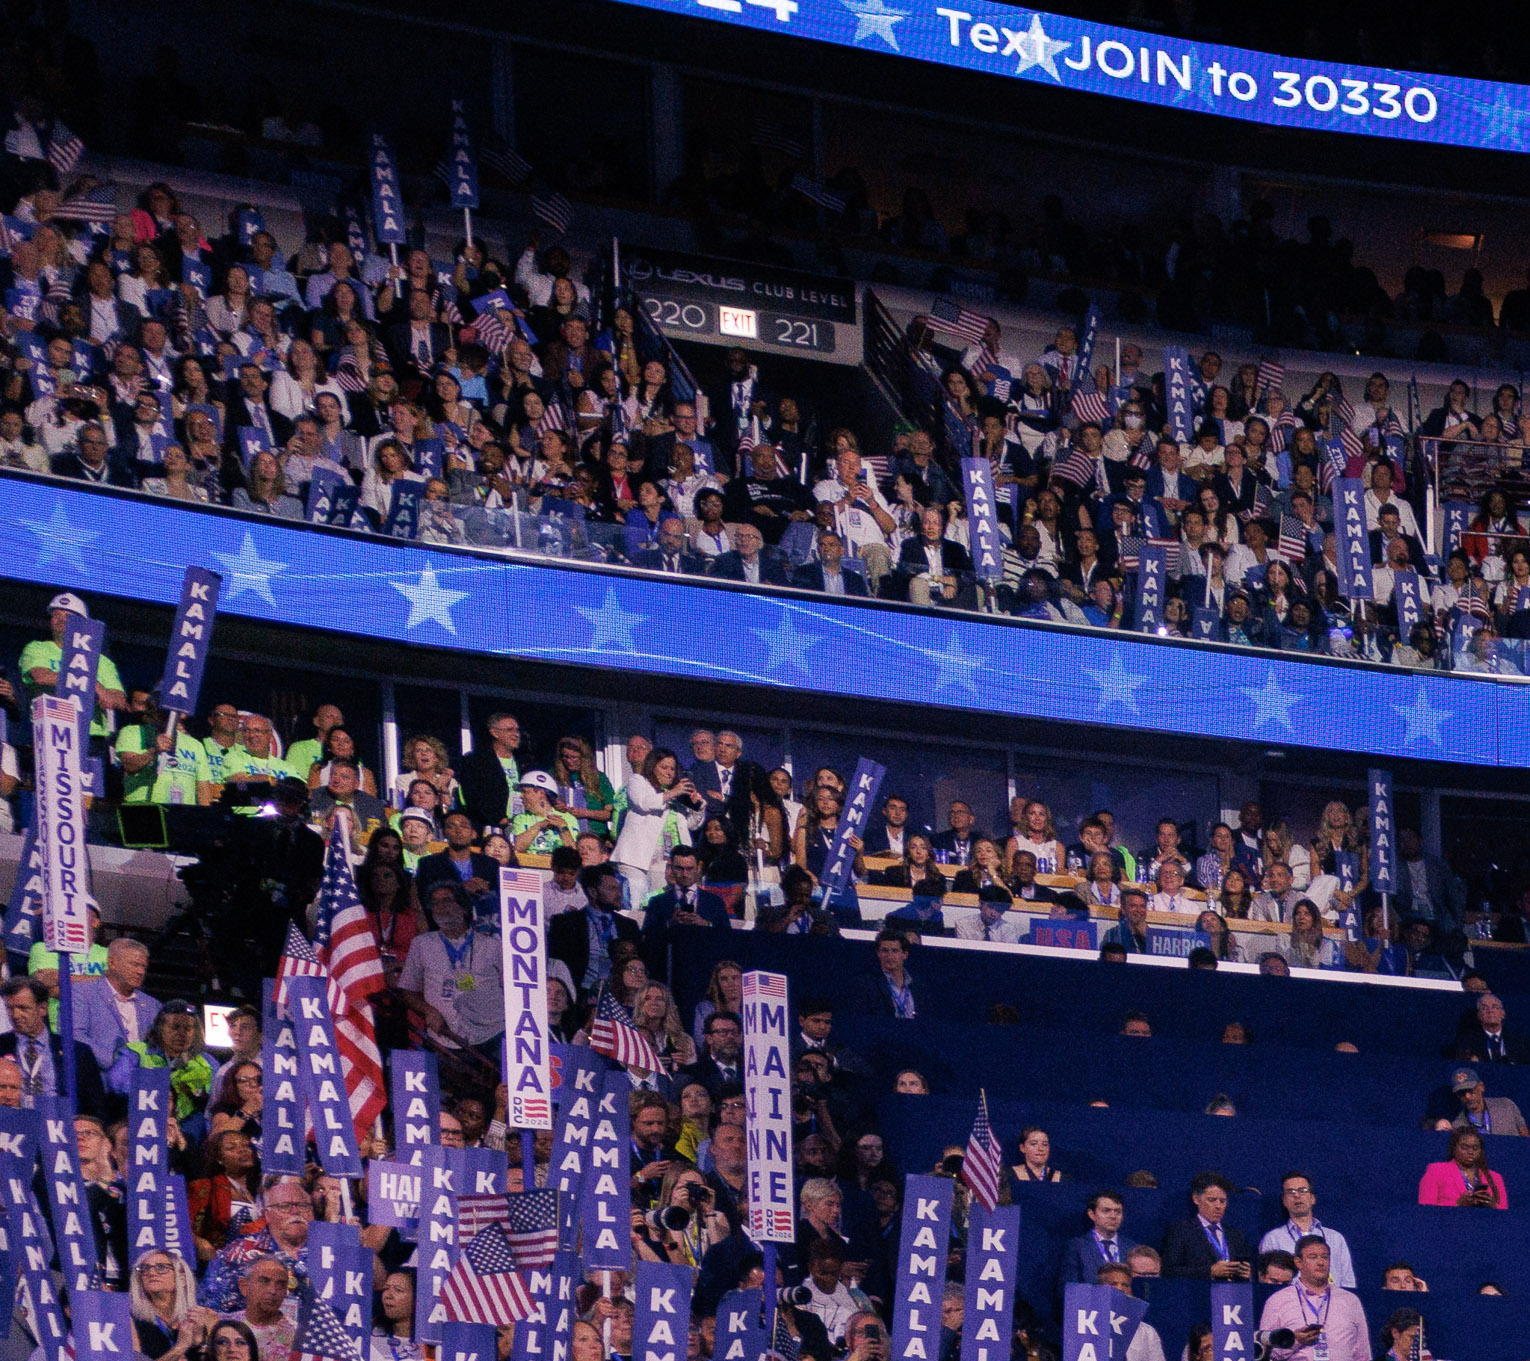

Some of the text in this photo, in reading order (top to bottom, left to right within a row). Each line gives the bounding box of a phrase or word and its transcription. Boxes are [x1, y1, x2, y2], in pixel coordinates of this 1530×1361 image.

[936, 8, 1440, 125] Text JOIN to 30330
[373, 133, 398, 231] KAMALA
[452, 100, 472, 196] KAMALA
[645, 297, 706, 329] 220
[655, 266, 849, 309] LEXUS CLUB LEVEL
[722, 309, 757, 338] EXIT
[774, 315, 819, 348] 221
[29, 345, 55, 392] KAM
[1170, 357, 1188, 443] KAMALA
[392, 492, 414, 538] KAM
[969, 469, 997, 567] KAMALA
[1343, 489, 1368, 588] KAMALA
[1449, 509, 1463, 551] KAM
[170, 581, 210, 699] KAMALA
[1142, 559, 1160, 633] KAMA
[1401, 581, 1419, 634] KAM
[65, 632, 94, 713] KAMA
[50, 723, 77, 917] MISSOURI
[829, 774, 875, 876] KAMALA
[1374, 782, 1392, 881] KAMALA
[1036, 926, 1091, 950] USA
[506, 896, 544, 1093] MONTANA
[302, 997, 349, 1157] KAMALA
[405, 1070, 432, 1167] KAM
[512, 1097, 522, 1125] DNC
[523, 1118, 549, 1126] 2024
[760, 1005, 790, 1204] MAINE
[135, 1089, 159, 1248] KAMALA
[559, 1068, 597, 1227] KAMA
[592, 1092, 620, 1250] KAMALA
[46, 1119, 89, 1292] KAMALA
[765, 1209, 774, 1238] DNC
[903, 1197, 940, 1360] KAMALA
